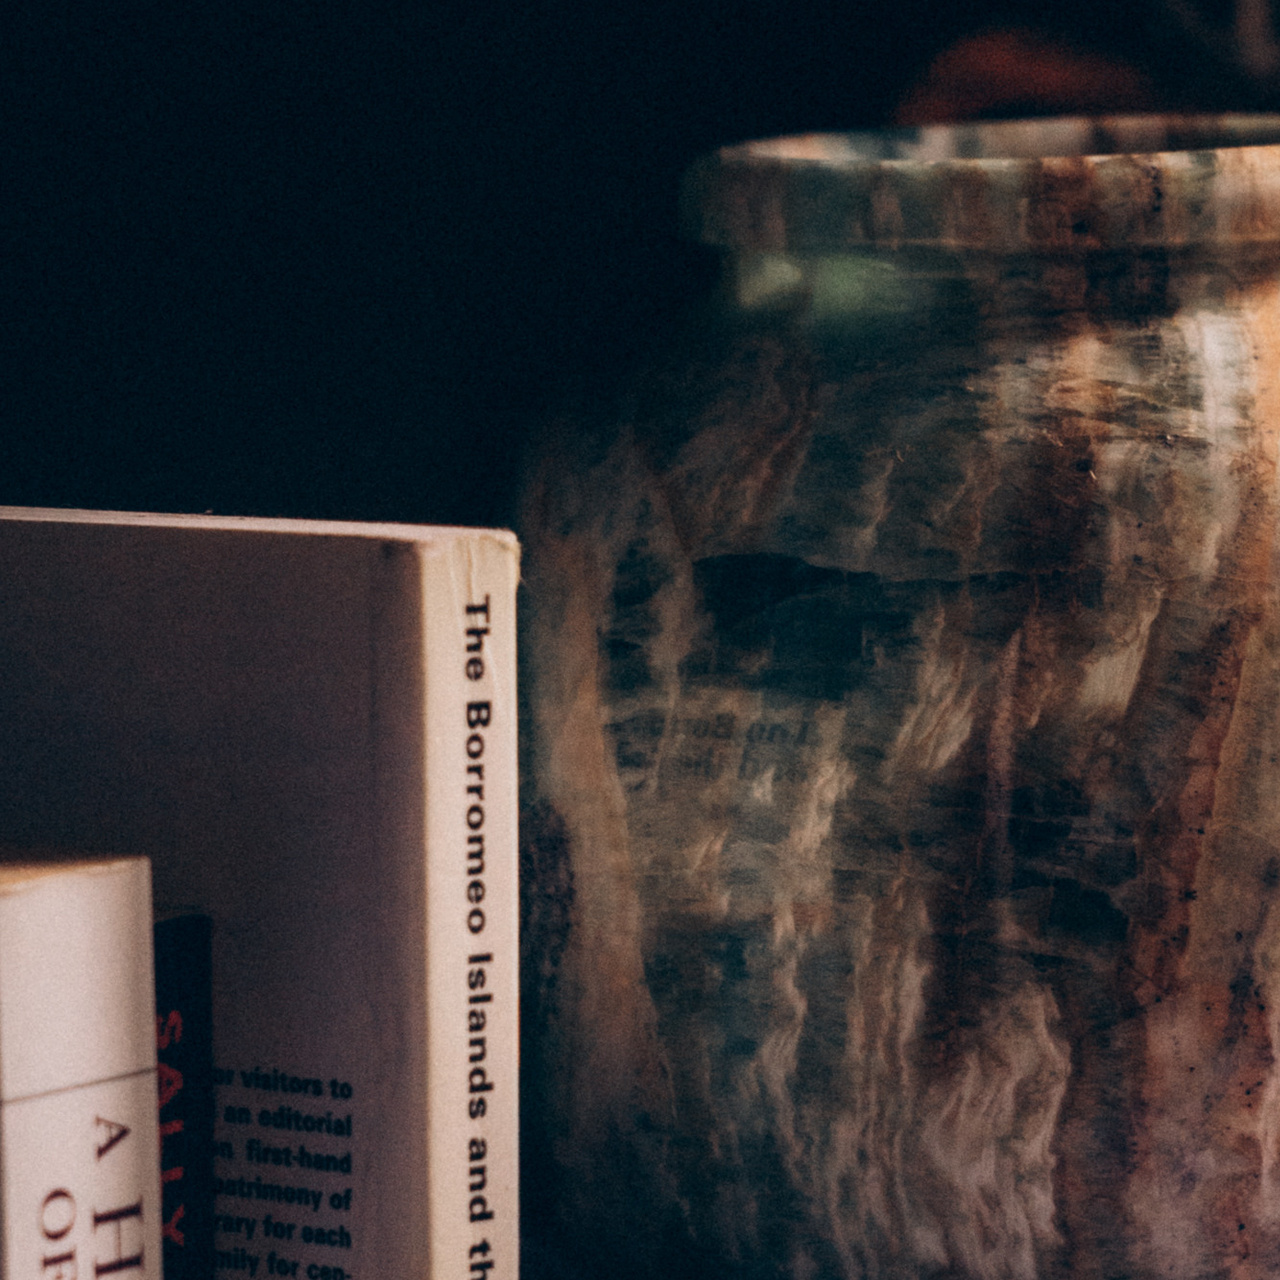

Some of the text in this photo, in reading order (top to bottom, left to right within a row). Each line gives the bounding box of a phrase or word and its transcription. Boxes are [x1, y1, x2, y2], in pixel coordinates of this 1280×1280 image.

[465, 593, 490, 682] The
[466, 700, 491, 935] Borromeo
[467, 953, 493, 1120] Islands
[241, 1066, 322, 1096] visitors
[330, 1079, 352, 1099] to
[94, 1115, 132, 1162] A
[157, 1009, 184, 1246] SALLY
[224, 1105, 352, 1136] an editorial
[247, 1140, 352, 1173] first-hand
[330, 1188, 352, 1210] of
[468, 1136, 493, 1223] and
[263, 1214, 295, 1239] for
[302, 1225, 351, 1249] each
[267, 1251, 299, 1276] for
